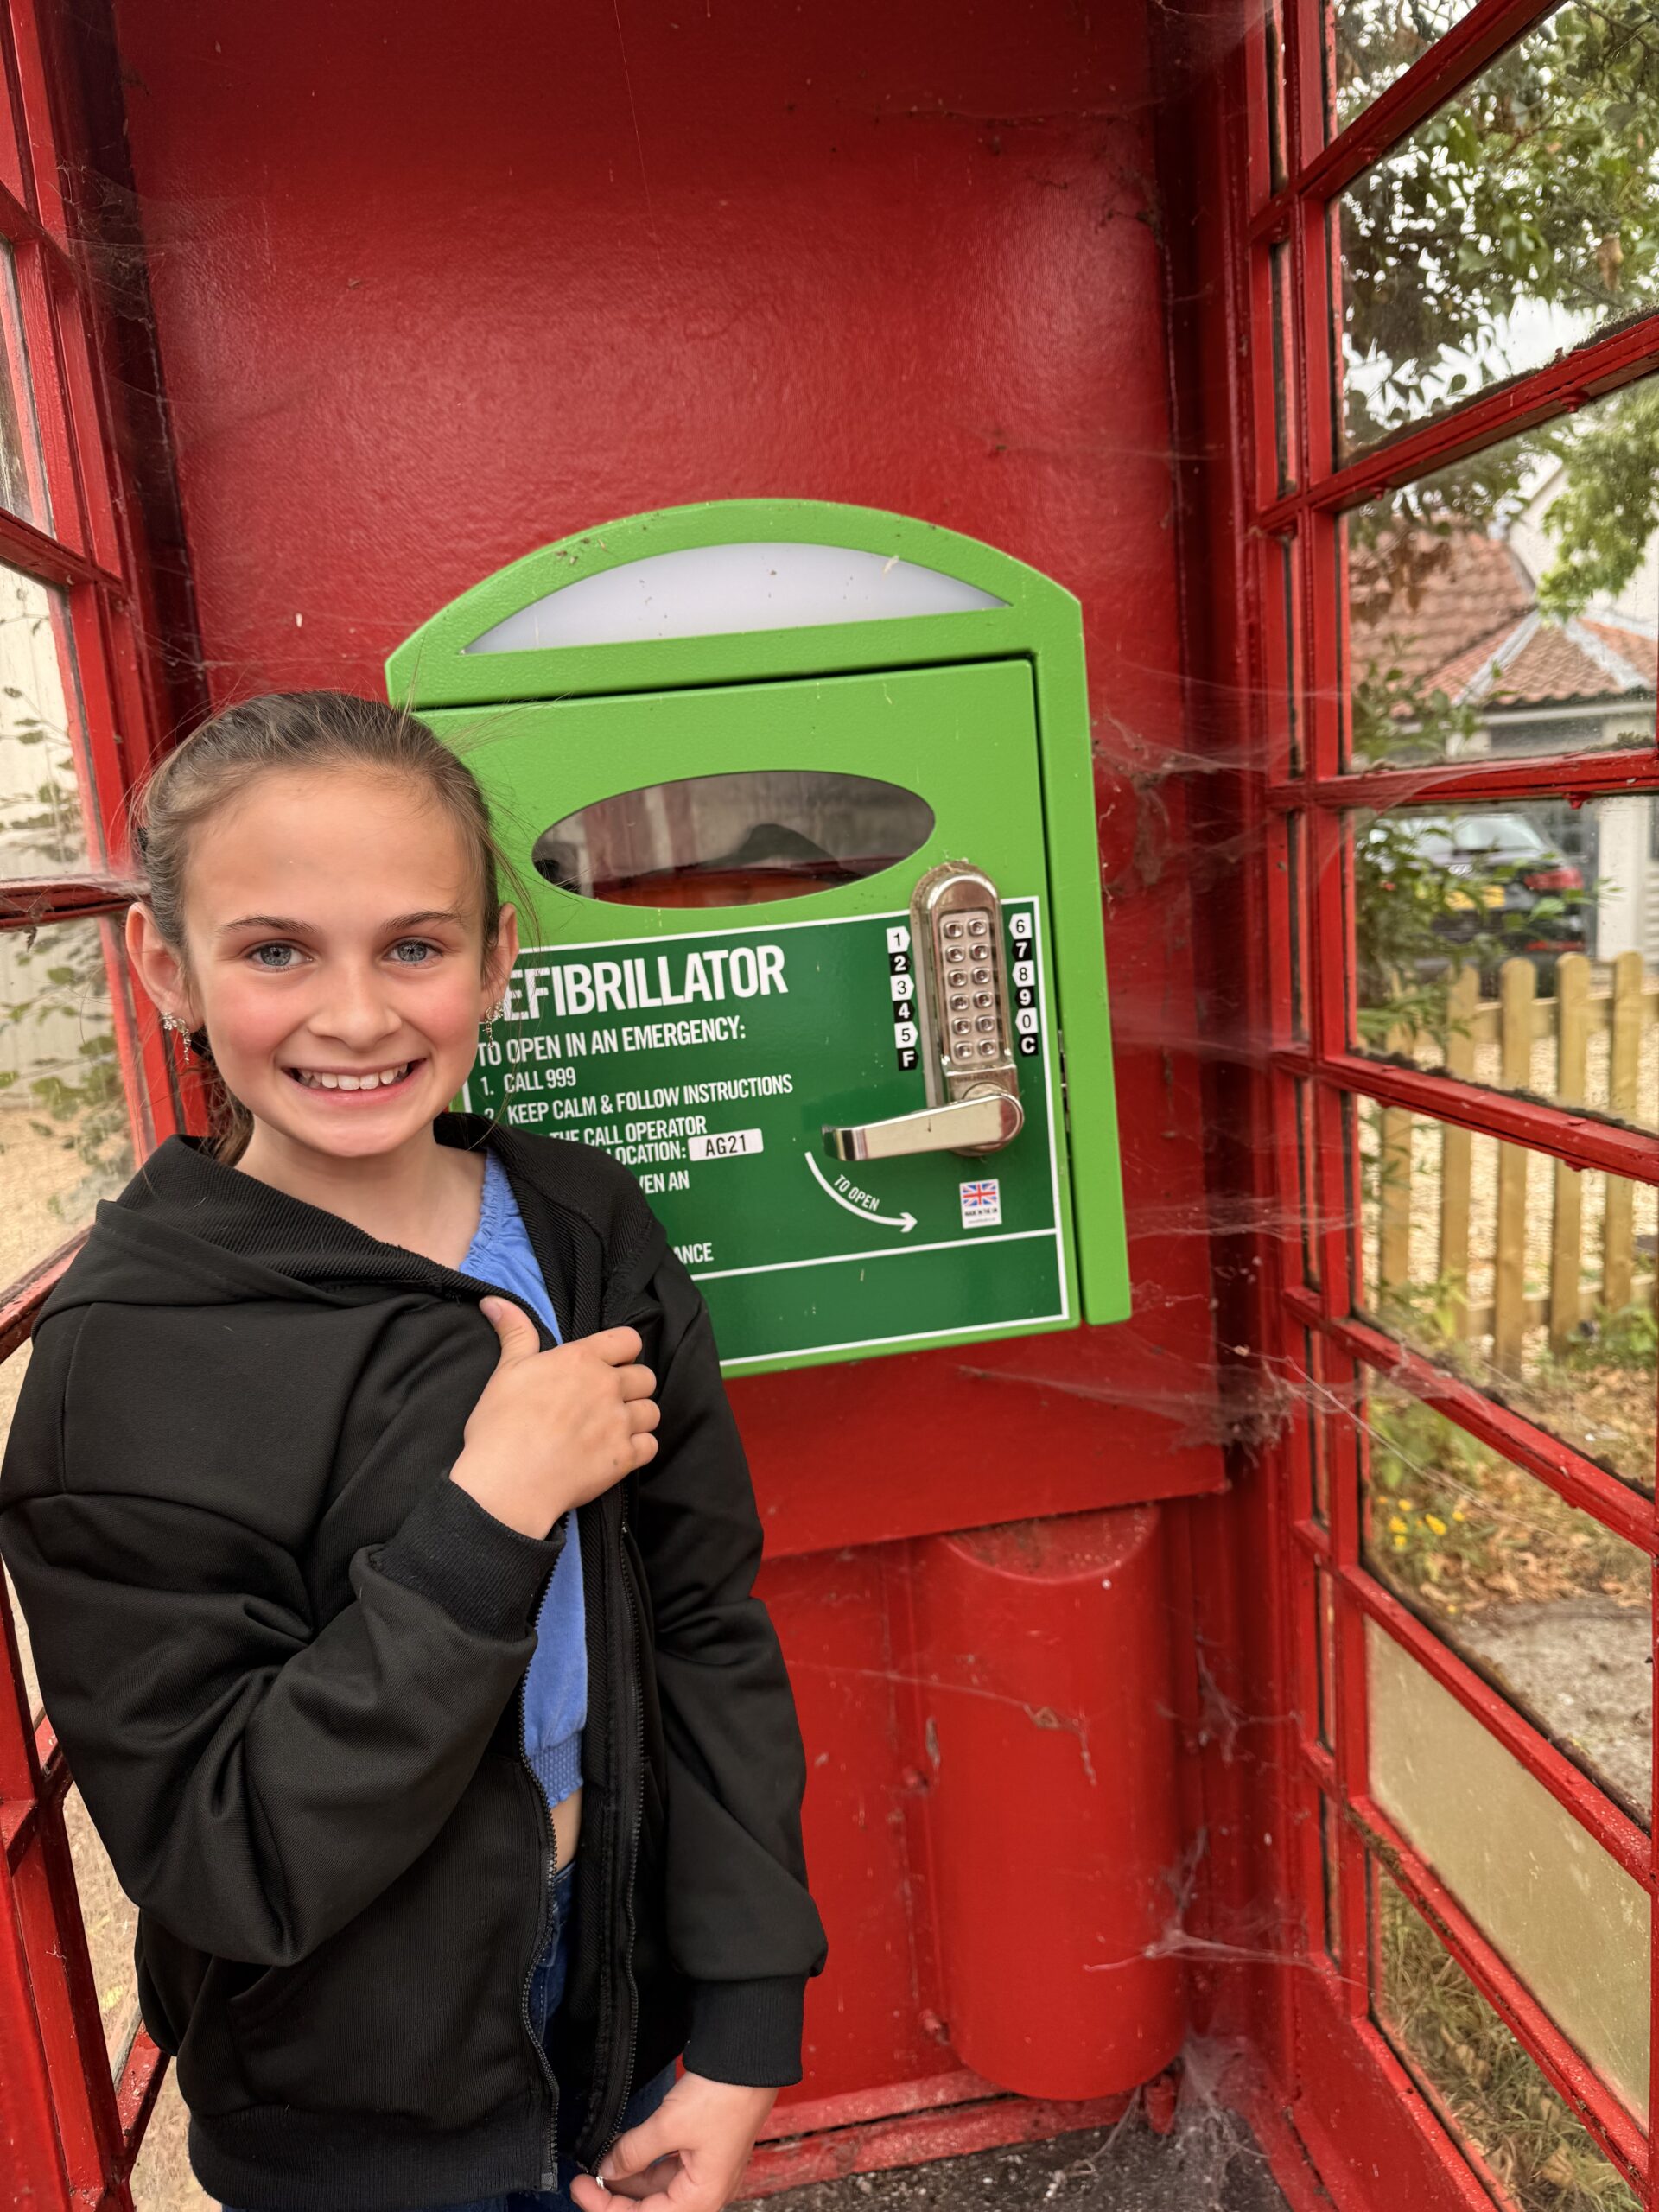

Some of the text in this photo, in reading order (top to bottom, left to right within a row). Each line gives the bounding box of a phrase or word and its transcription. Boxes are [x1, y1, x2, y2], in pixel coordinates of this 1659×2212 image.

[1015, 918, 1026, 934] 6
[1014, 942, 1027, 958] 7
[893, 955, 906, 972] 2
[1018, 966, 1028, 982] 8
[480, 944, 789, 1025] EFIBRILLATOR
[896, 980, 907, 995] 3
[1018, 989, 1031, 1006] 9
[898, 1002, 911, 1019] 4
[1021, 1014, 1032, 1028] 0
[478, 1015, 746, 1067] TO OPEN IN AN EMERGENCY:
[901, 1027, 912, 1042] 5
[1020, 1037, 1036, 1054] C
[902, 1051, 914, 1067] F
[480, 1066, 577, 1096] 1. CALL 999
[507, 1101, 550, 1125] KEEP
[552, 1096, 598, 1120] CALM
[601, 1094, 614, 1115] &
[616, 1085, 681, 1113] FOLLOW
[683, 1073, 794, 1104] INSTRUCTIONS
[583, 1124, 624, 1147] CALL
[625, 1115, 708, 1143] OPERATOR
[606, 1134, 747, 1166] OCATION: AG21
[668, 1169, 690, 1192] AN
[834, 1173, 880, 1212] TO OPEN
[673, 1242, 715, 1265] ANCE
